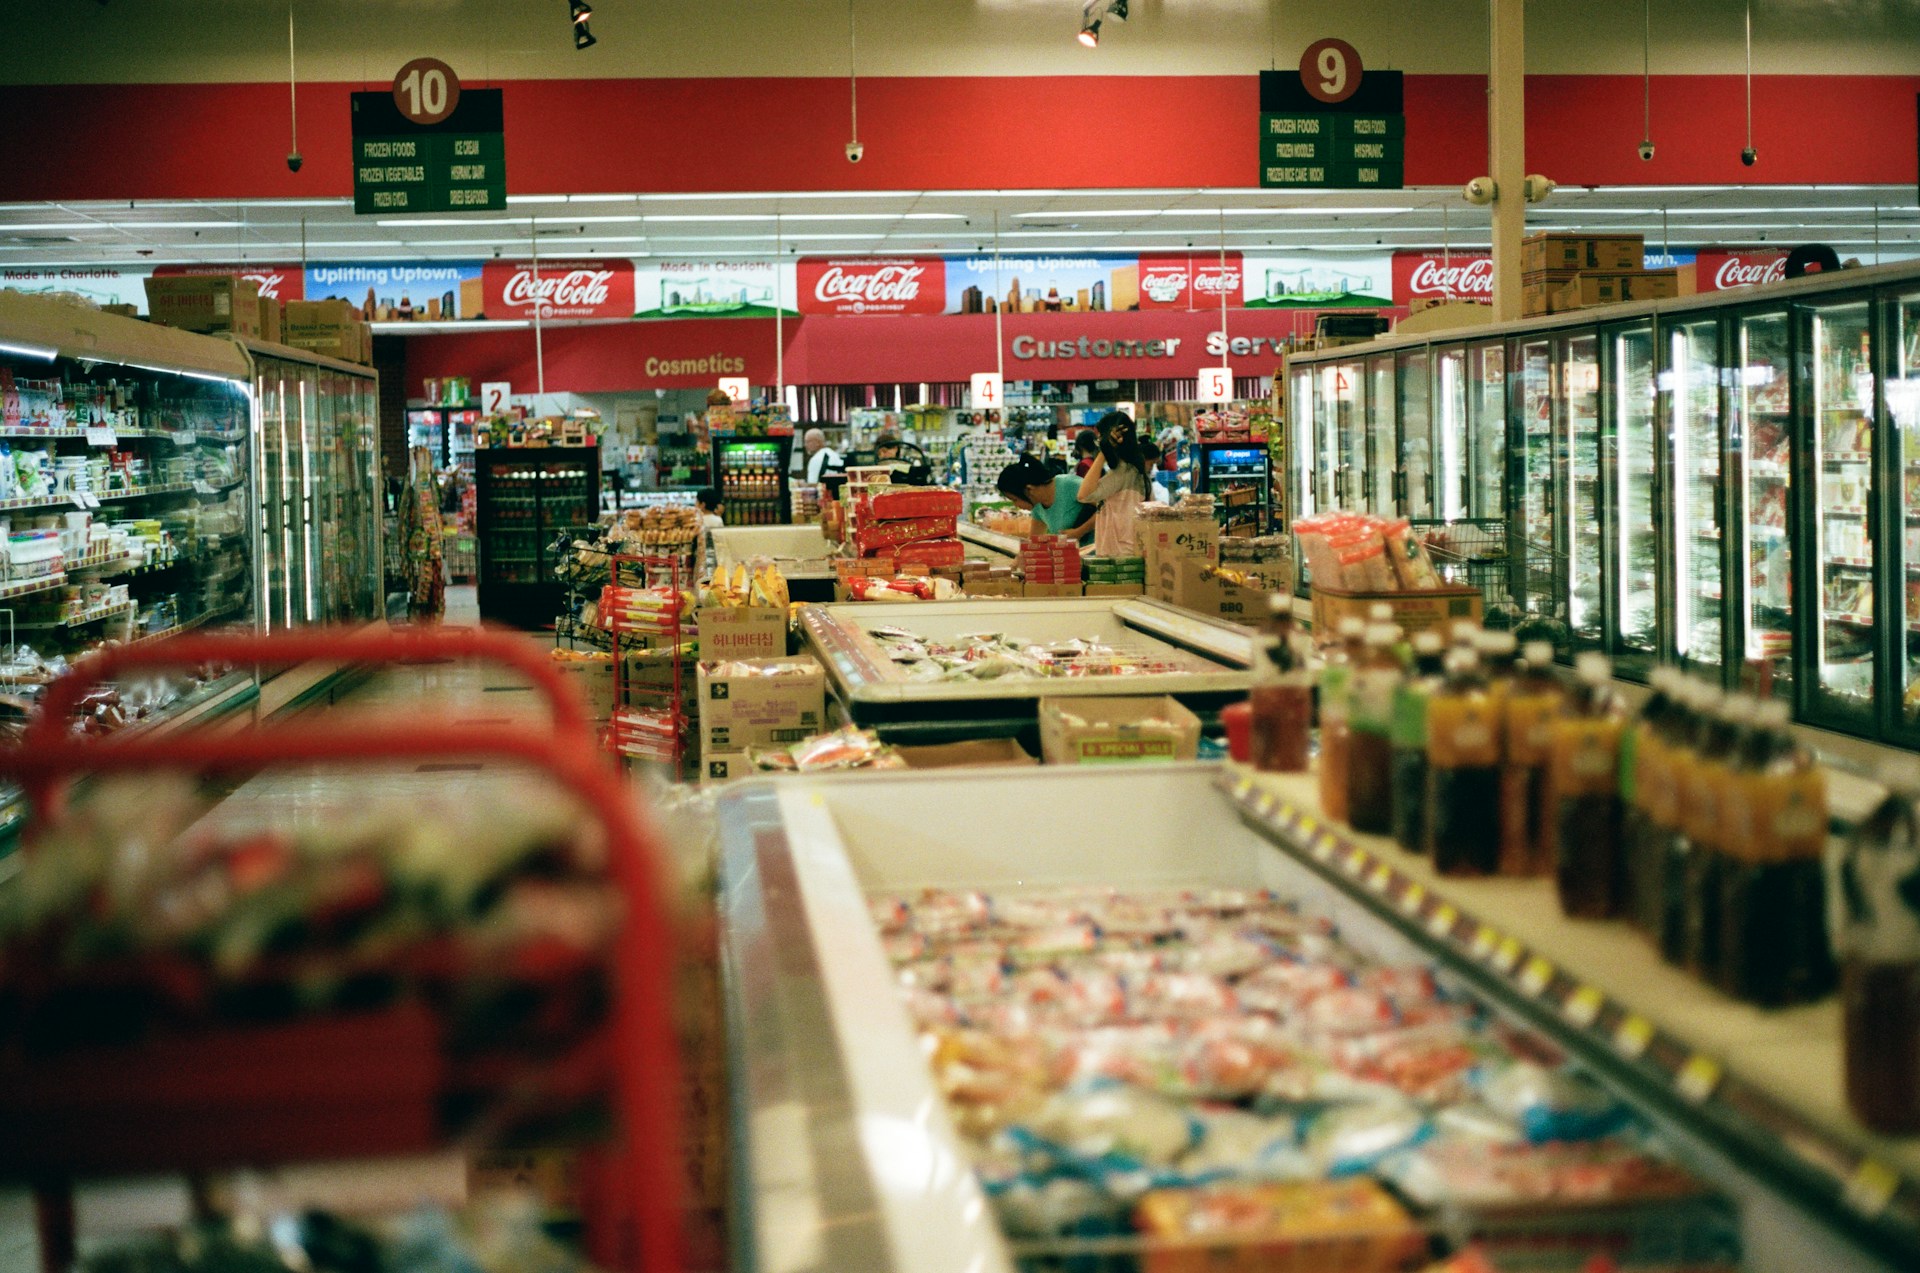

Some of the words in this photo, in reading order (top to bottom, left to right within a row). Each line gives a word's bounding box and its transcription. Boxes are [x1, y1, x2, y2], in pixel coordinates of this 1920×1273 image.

[1318, 48, 1346, 94] 9
[402, 69, 447, 114] 10
[1271, 119, 1296, 133] FROZEN
[1297, 119, 1319, 133] FOODS
[364, 143, 391, 157] FROZEN
[392, 142, 416, 157] FOODS
[360, 168, 384, 182] FROZEN
[385, 166, 424, 181] VEGETABLES
[4, 270, 38, 280] Made
[44, 269, 55, 279] in
[314, 267, 388, 285] Uplifting
[391, 266, 462, 283] Uptown.
[661, 262, 693, 271] Made
[700, 261, 711, 271] in
[1410, 259, 1493, 293] Coca-Col
[1012, 335, 1181, 359] Customer
[1206, 331, 1296, 356] Servi
[645, 353, 744, 377] Cosmetics
[982, 380, 994, 402] 4
[1213, 374, 1224, 397] 5
[490, 389, 502, 412] 2
[1176, 533, 1212, 554] 약과
[1220, 602, 1244, 613] BBQ
[713, 632, 774, 647] 허니버터칩
